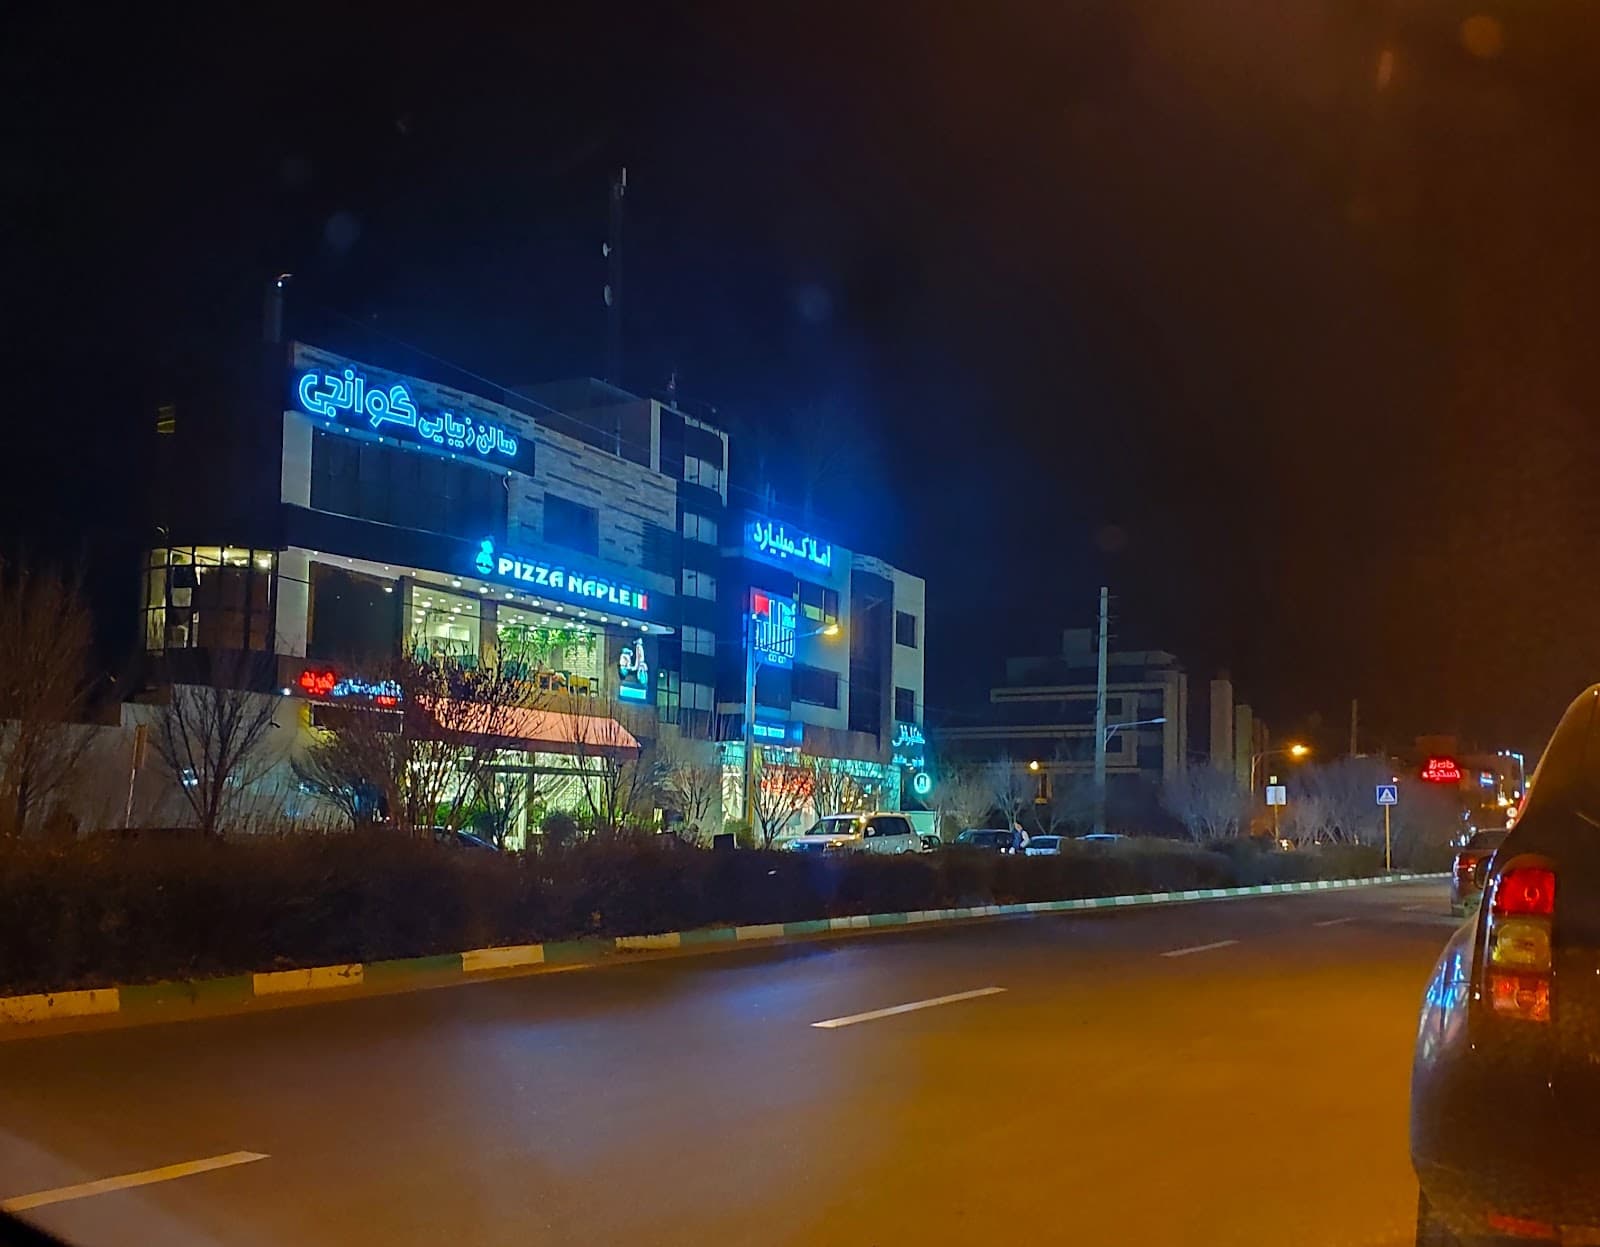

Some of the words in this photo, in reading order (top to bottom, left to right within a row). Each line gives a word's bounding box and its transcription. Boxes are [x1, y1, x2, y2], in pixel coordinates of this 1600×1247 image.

[299, 369, 417, 429] گوانجی
[418, 413, 475, 449] زیبایی
[476, 425, 517, 456] سالن
[753, 522, 795, 558] میلیارد
[794, 537, 831, 568] املاک
[498, 557, 564, 588] PIZZA
